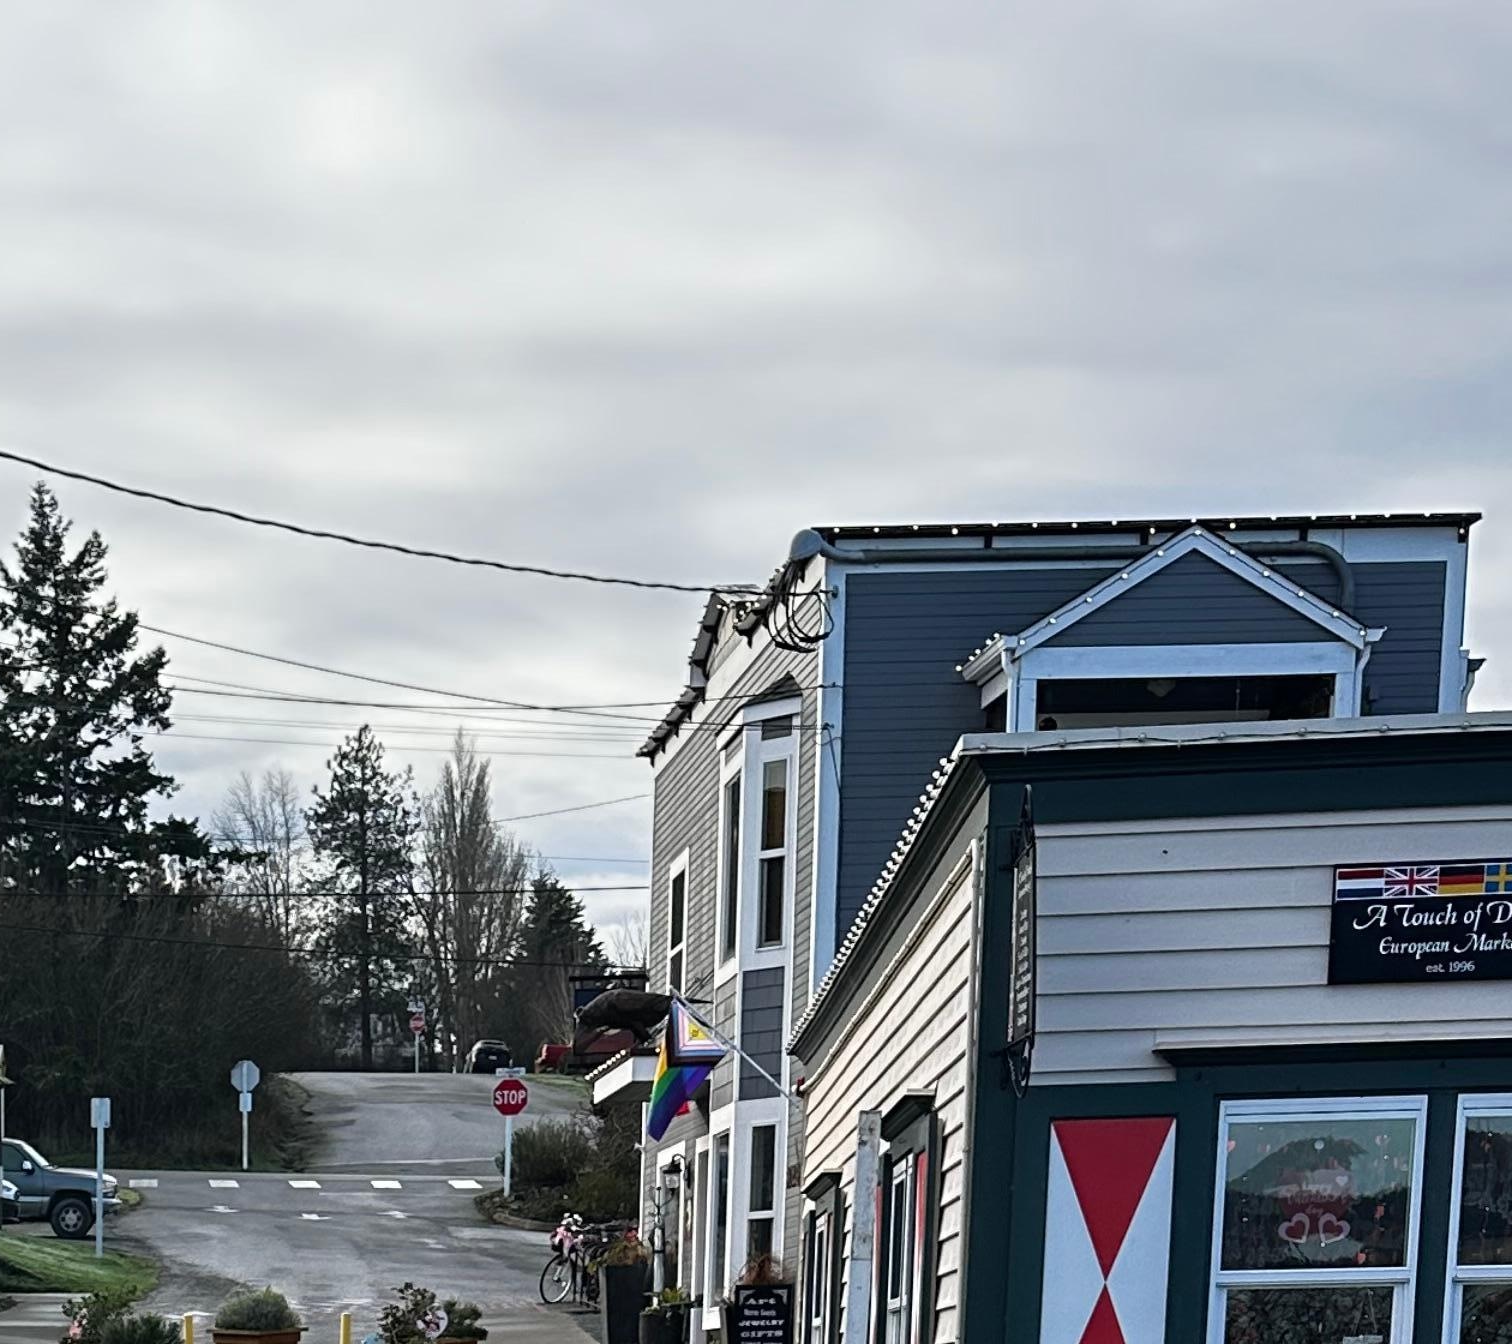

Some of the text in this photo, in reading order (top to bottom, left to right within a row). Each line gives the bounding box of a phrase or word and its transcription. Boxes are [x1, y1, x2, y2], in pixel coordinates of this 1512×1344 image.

[1353, 904, 1388, 930] A
[1393, 903, 1458, 927] Touch
[1463, 902, 1484, 932] of
[1379, 936, 1450, 960] European
[1448, 960, 1476, 973] 1996
[495, 1090, 527, 1105] STOP
[738, 1319, 784, 1327] JEWELRY
[740, 1330, 783, 1338] GIFTS
